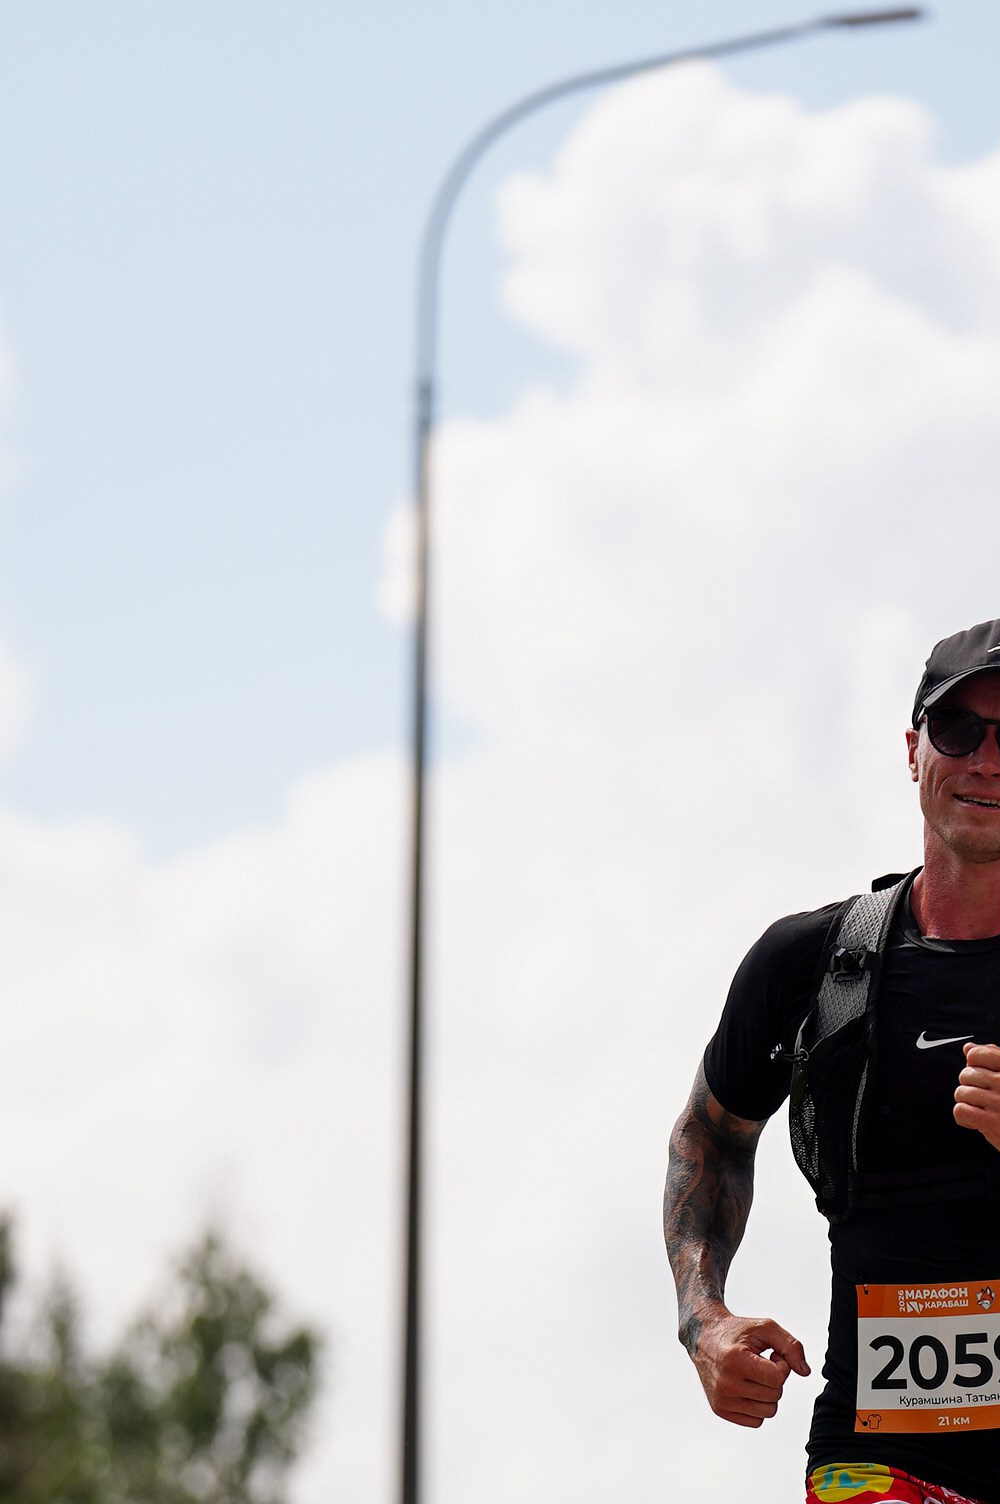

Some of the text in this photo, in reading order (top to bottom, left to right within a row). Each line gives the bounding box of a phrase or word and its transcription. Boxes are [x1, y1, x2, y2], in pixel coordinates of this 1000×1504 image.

[905, 1287, 968, 1300] МАРАФОН
[898, 1289, 906, 1312] 2026
[924, 1299, 969, 1309] КАРАБАШ
[899, 1394, 963, 1407] Курамшина
[938, 1416, 950, 1426] 21
